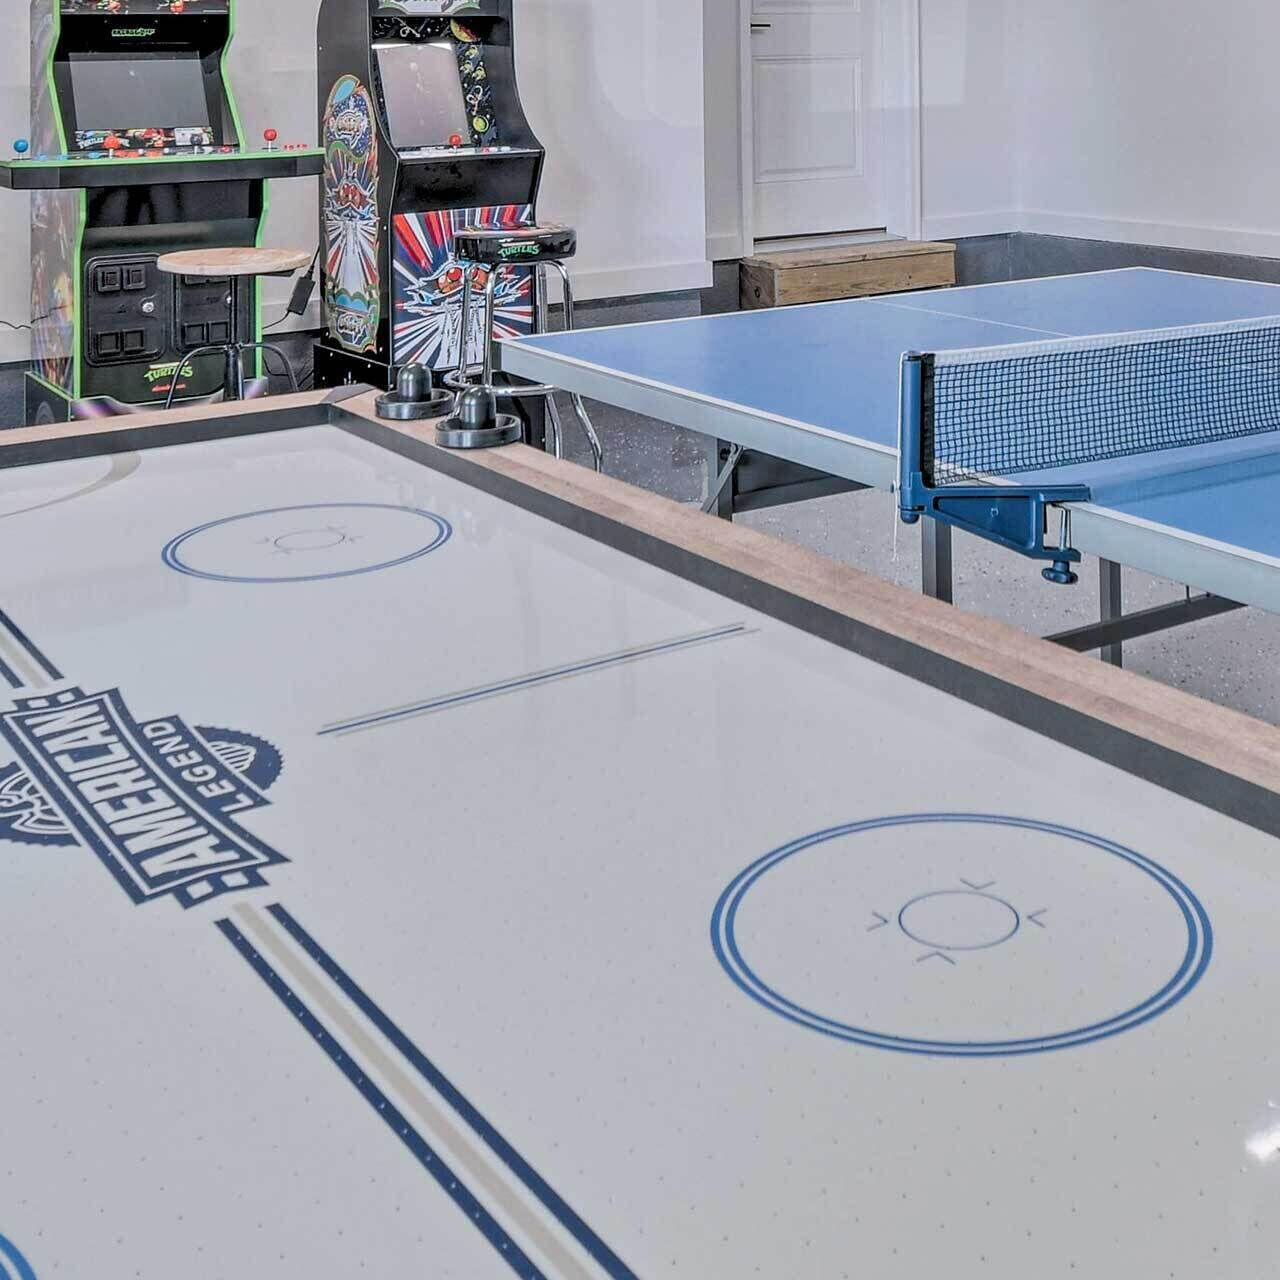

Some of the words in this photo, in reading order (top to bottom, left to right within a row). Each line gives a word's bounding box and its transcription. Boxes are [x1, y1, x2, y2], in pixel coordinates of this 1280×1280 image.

[498, 244, 540, 258] TURTLES
[24, 703, 240, 879] AMERICAN
[141, 720, 254, 814] LEGEND
